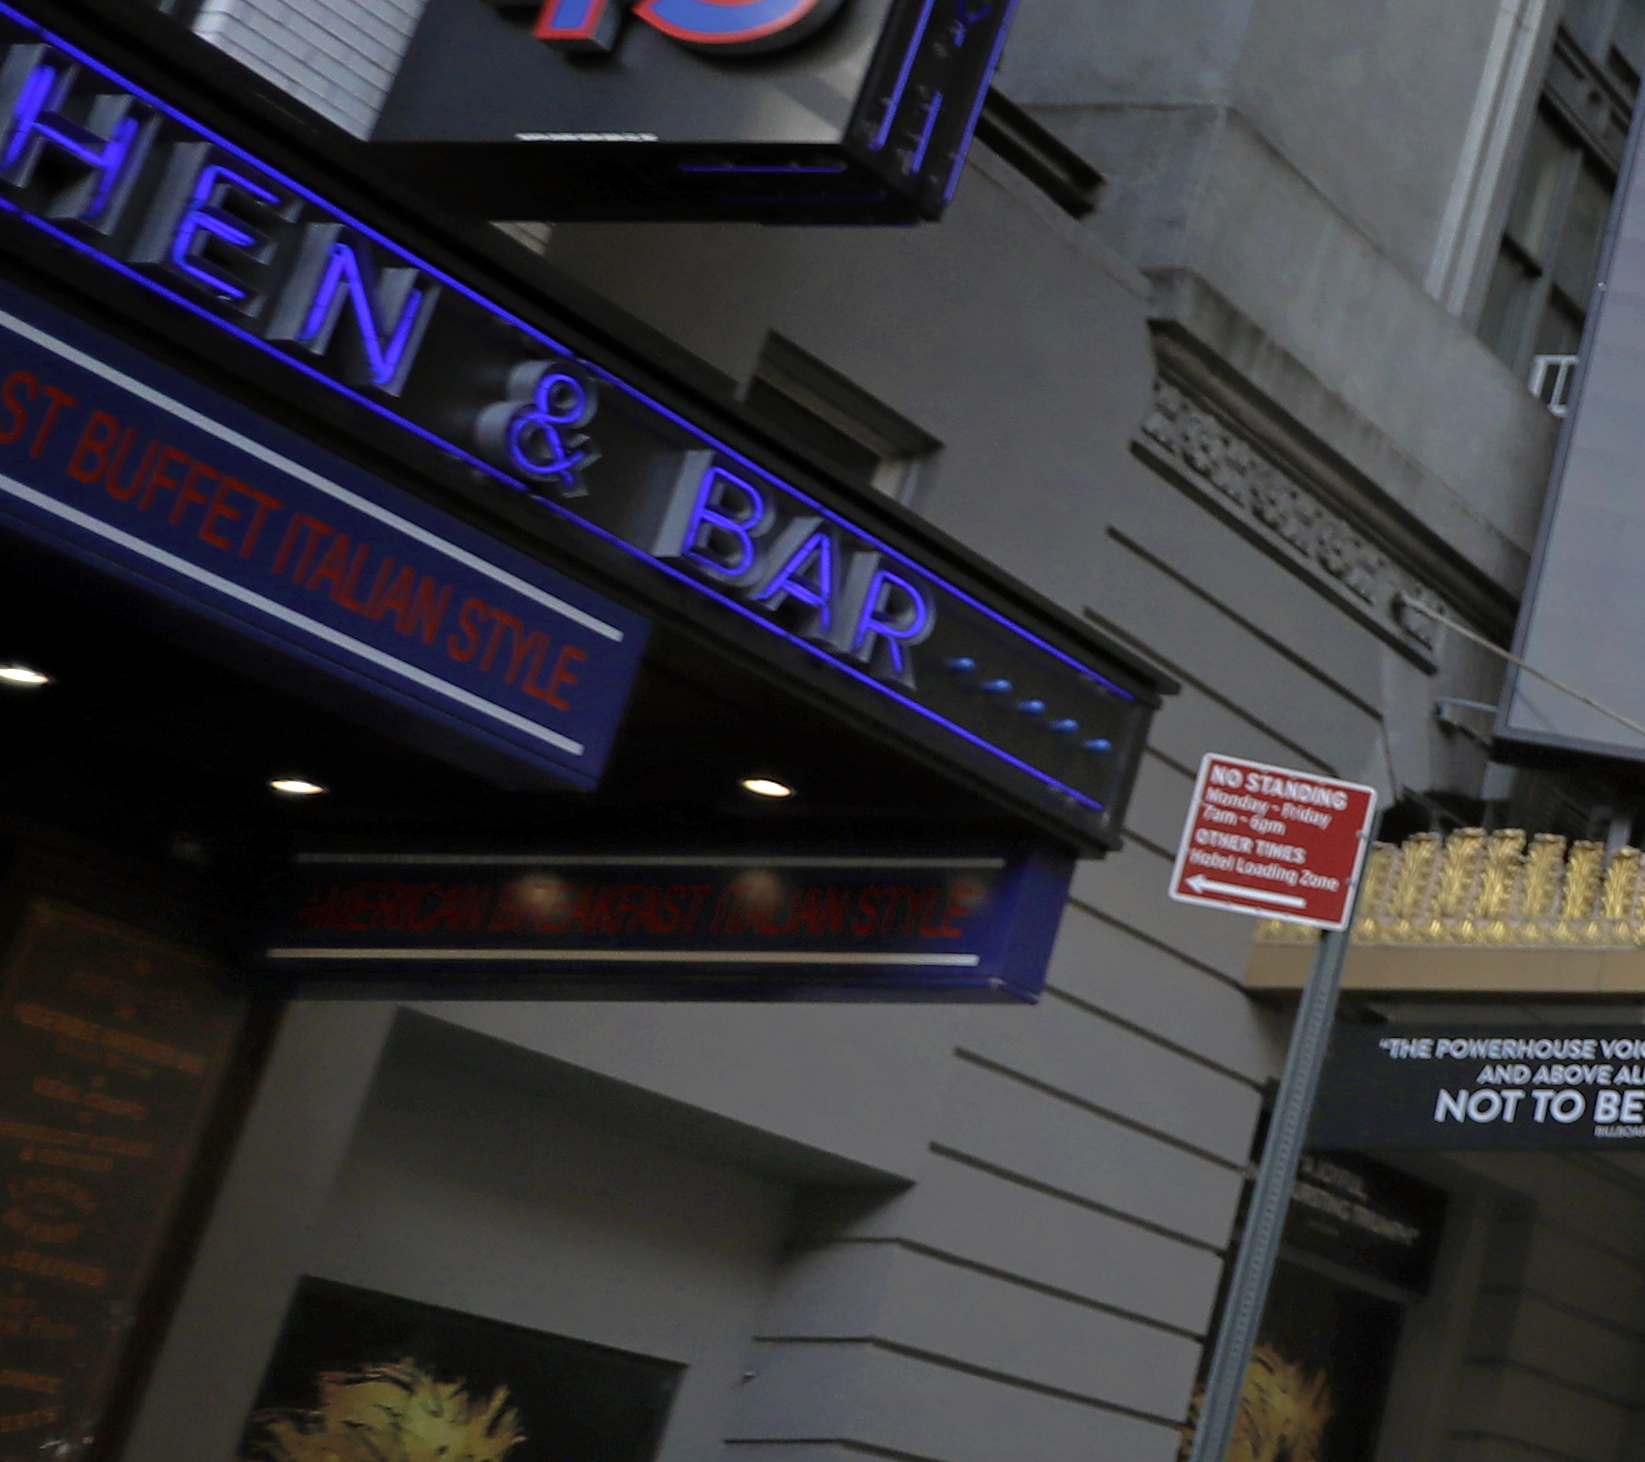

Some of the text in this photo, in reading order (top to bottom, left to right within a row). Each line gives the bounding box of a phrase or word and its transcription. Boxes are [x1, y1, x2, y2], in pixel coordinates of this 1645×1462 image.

[3, 43, 938, 690] HEN & BAR
[66, 411, 283, 558] BUFFET
[272, 512, 454, 646] ITALIAN
[447, 598, 588, 711] STYLE
[1209, 764, 1349, 811] NO STANDING
[1201, 803, 1238, 826] 7am
[1204, 787, 1270, 816] Monday
[1280, 803, 1332, 830] Friday
[1195, 828, 1307, 865] OTHER TIMES
[1189, 848, 1340, 892] Hotel Loading Zone
[1435, 1039, 1598, 1061] POWERHOUSE
[1476, 1065, 1533, 1085] AND
[1533, 1066, 1613, 1085] ABOVE
[1434, 1090, 1526, 1124] NOT
[1532, 1090, 1586, 1124] TO
[1594, 1090, 1645, 1124] BE
